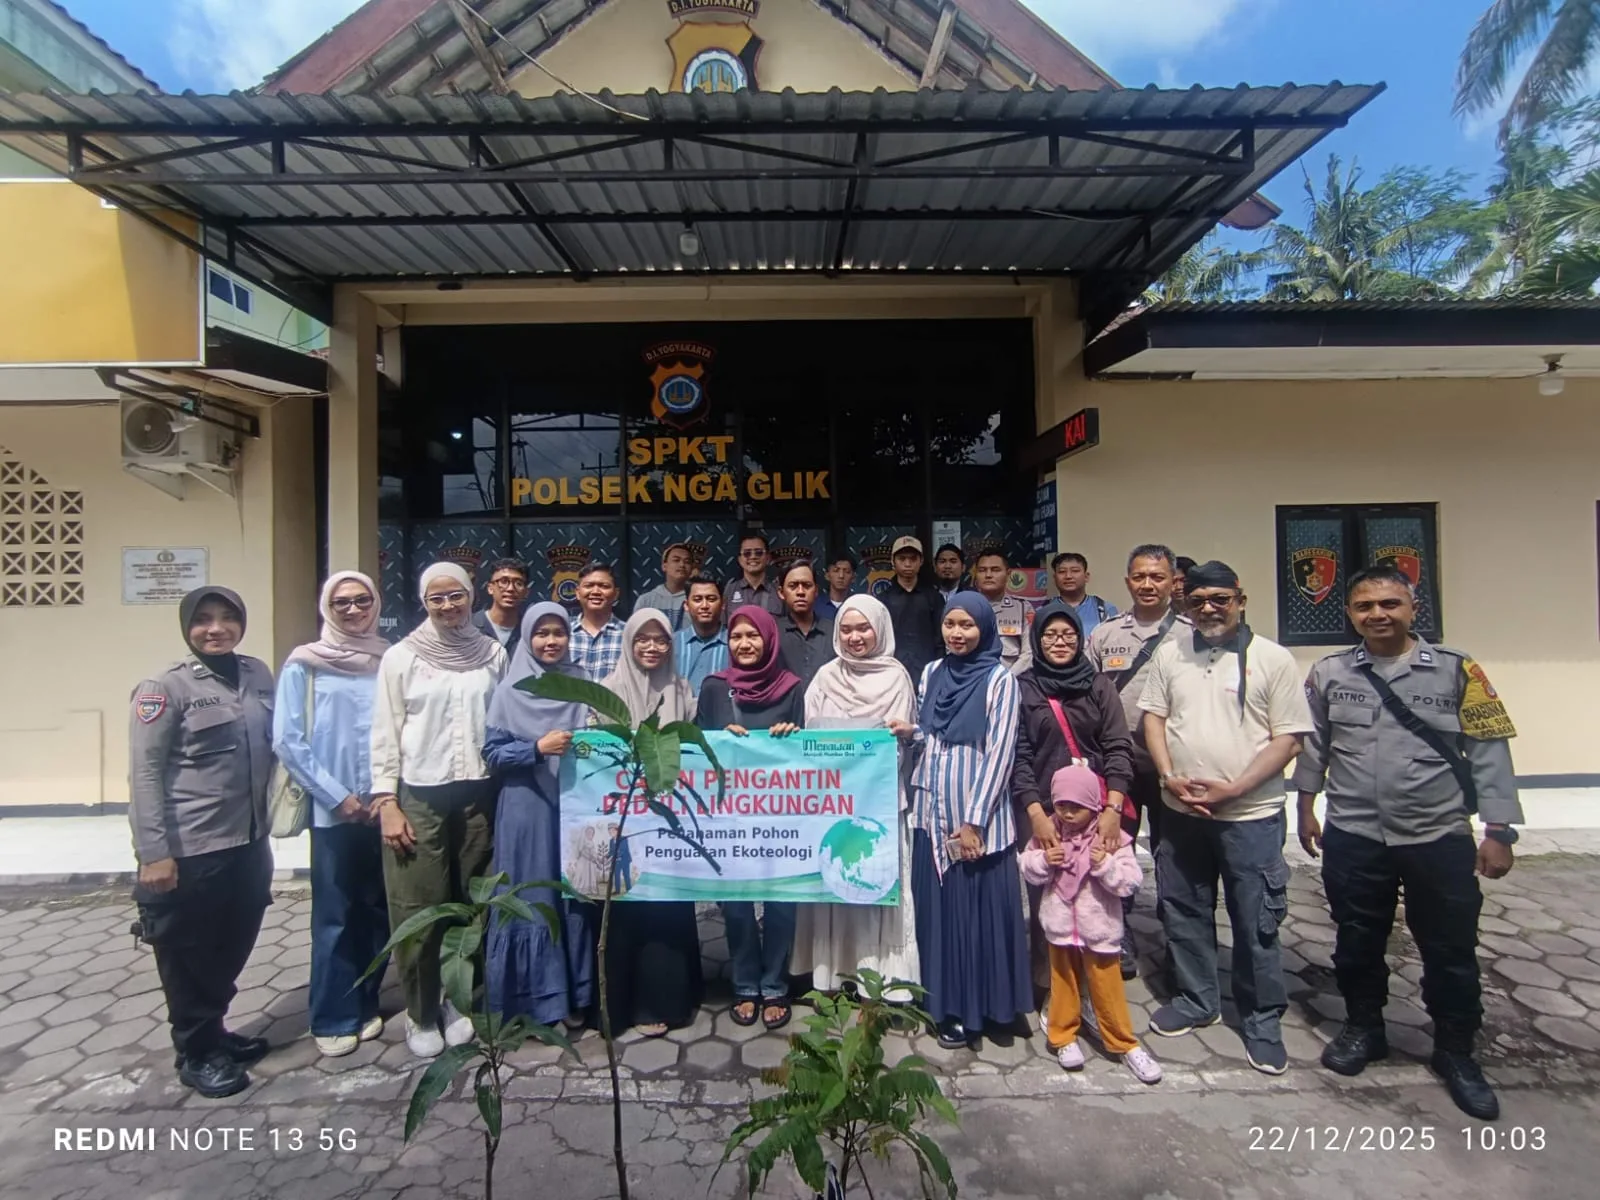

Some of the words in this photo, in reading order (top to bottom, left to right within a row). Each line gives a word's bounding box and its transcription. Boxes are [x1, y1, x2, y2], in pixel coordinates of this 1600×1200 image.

[628, 436, 734, 465] SPKT
[511, 473, 652, 507] POLSEK
[191, 696, 221, 708] YULLY
[1332, 691, 1366, 703] RATNO
[615, 769, 695, 790] CAN
[704, 769, 841, 790] PENGANTIN
[602, 794, 688, 816] PEDLI
[752, 827, 799, 839] Pohon
[732, 845, 812, 861] Ekoteologi
